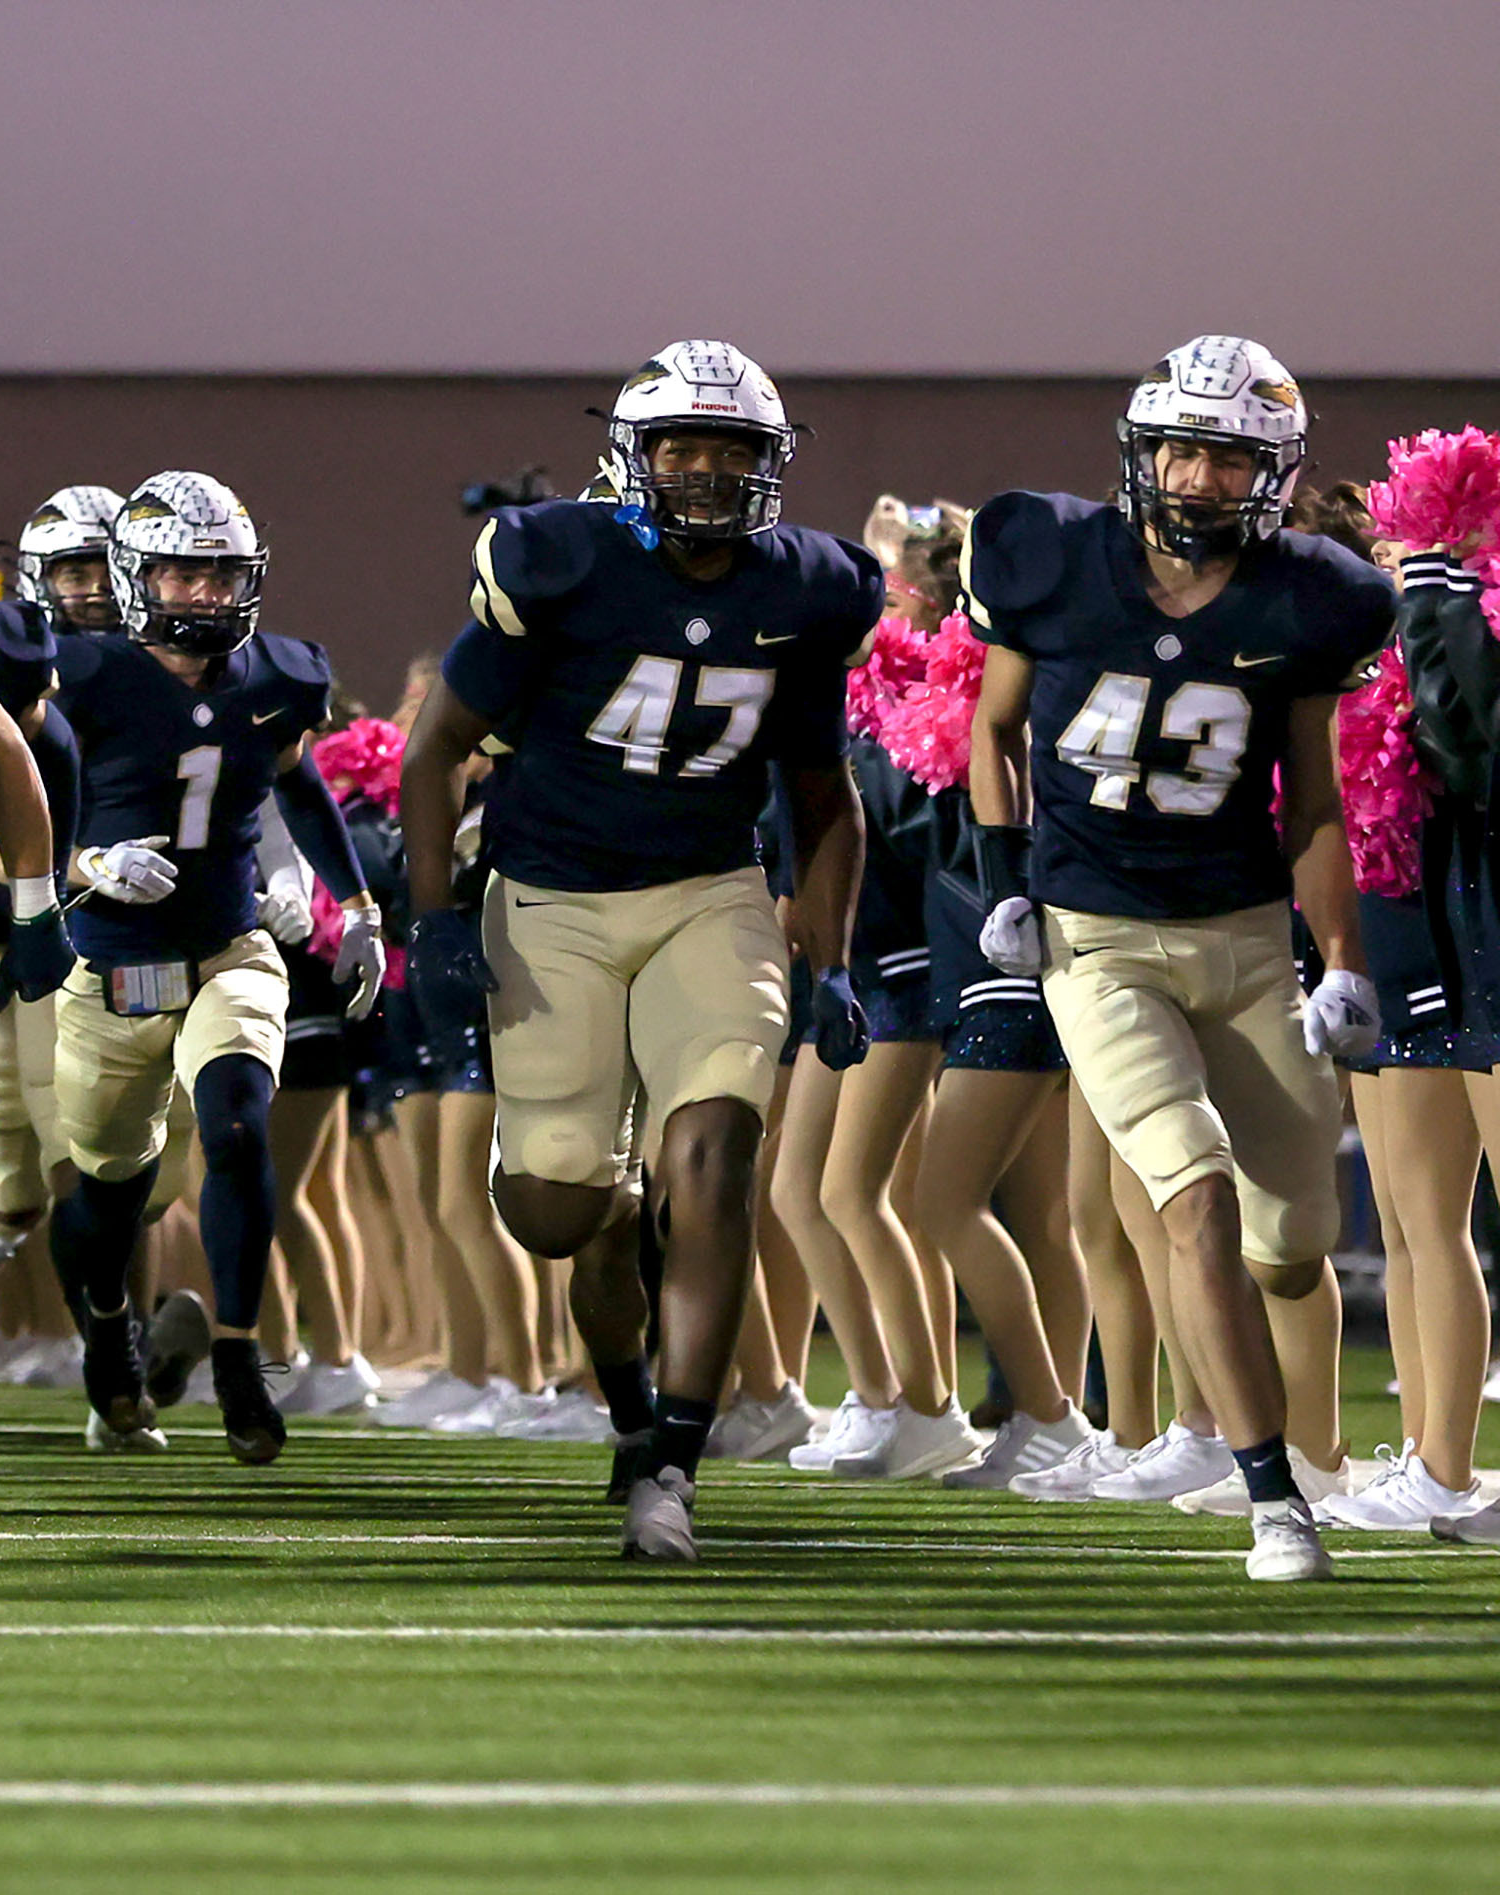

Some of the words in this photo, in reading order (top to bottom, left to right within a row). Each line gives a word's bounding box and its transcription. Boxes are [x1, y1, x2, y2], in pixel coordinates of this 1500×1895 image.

[585, 654, 776, 777] 47
[1057, 672, 1252, 816] 43
[176, 745, 223, 850] 1
